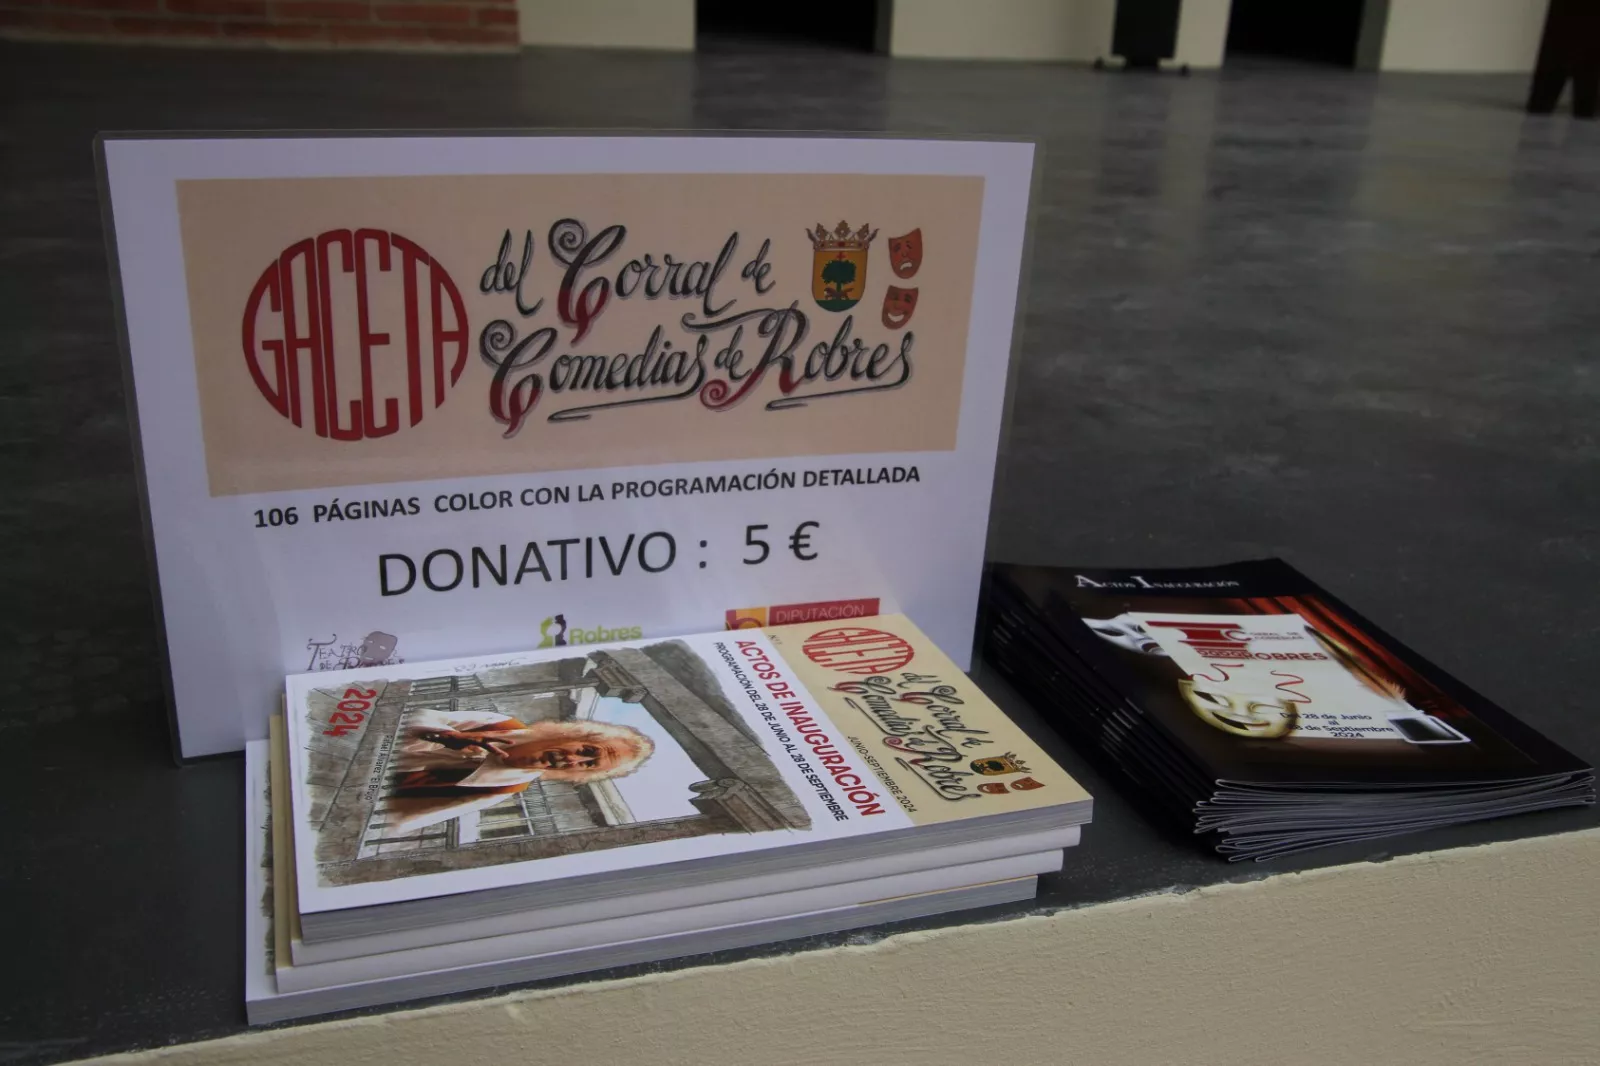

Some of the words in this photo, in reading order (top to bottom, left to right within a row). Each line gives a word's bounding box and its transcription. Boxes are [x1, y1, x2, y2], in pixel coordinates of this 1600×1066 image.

[479, 228, 544, 317] del
[548, 218, 739, 345] Corral
[742, 237, 777, 294] de
[242, 228, 469, 441] GACETA
[682, 300, 914, 412] Robres
[714, 325, 753, 380] de
[479, 319, 708, 439] Comedias
[254, 507, 299, 528] 106
[313, 497, 421, 523] PÁGINAS
[434, 490, 514, 513] COLOR
[520, 486, 570, 506] CON
[578, 484, 604, 502] LA
[611, 468, 796, 499] PROGRAMACIÓN
[803, 466, 921, 488] DETALLADA
[379, 532, 677, 597] DONATIVO
[743, 524, 770, 565] 5
[788, 521, 820, 561] €
[568, 624, 643, 645] Robres
[775, 604, 866, 624] DIPUTACIÓN
[714, 642, 754, 690] PROGRAMACIÓN
[734, 640, 782, 680] ACTOS
[1243, 652, 1329, 661] ROBRES
[323, 688, 377, 737] 2024
[746, 689, 762, 703] DEL
[755, 702, 769, 712] 28
[765, 682, 796, 699] DE
[890, 685, 989, 738] Corral
[761, 711, 777, 722] DE
[768, 722, 791, 744] JUNIO
[827, 676, 925, 737] Comedias
[882, 725, 982, 801] Robres
[779, 701, 885, 817] INAUGURACIÓN
[783, 742, 797, 753] AL
[791, 753, 805, 763] 28
[797, 762, 814, 774] DE
[806, 771, 849, 821] SEPTIEMBRE
[847, 736, 903, 797] JUNIO-SEPTIEMBRE
[896, 796, 918, 813] 2024
